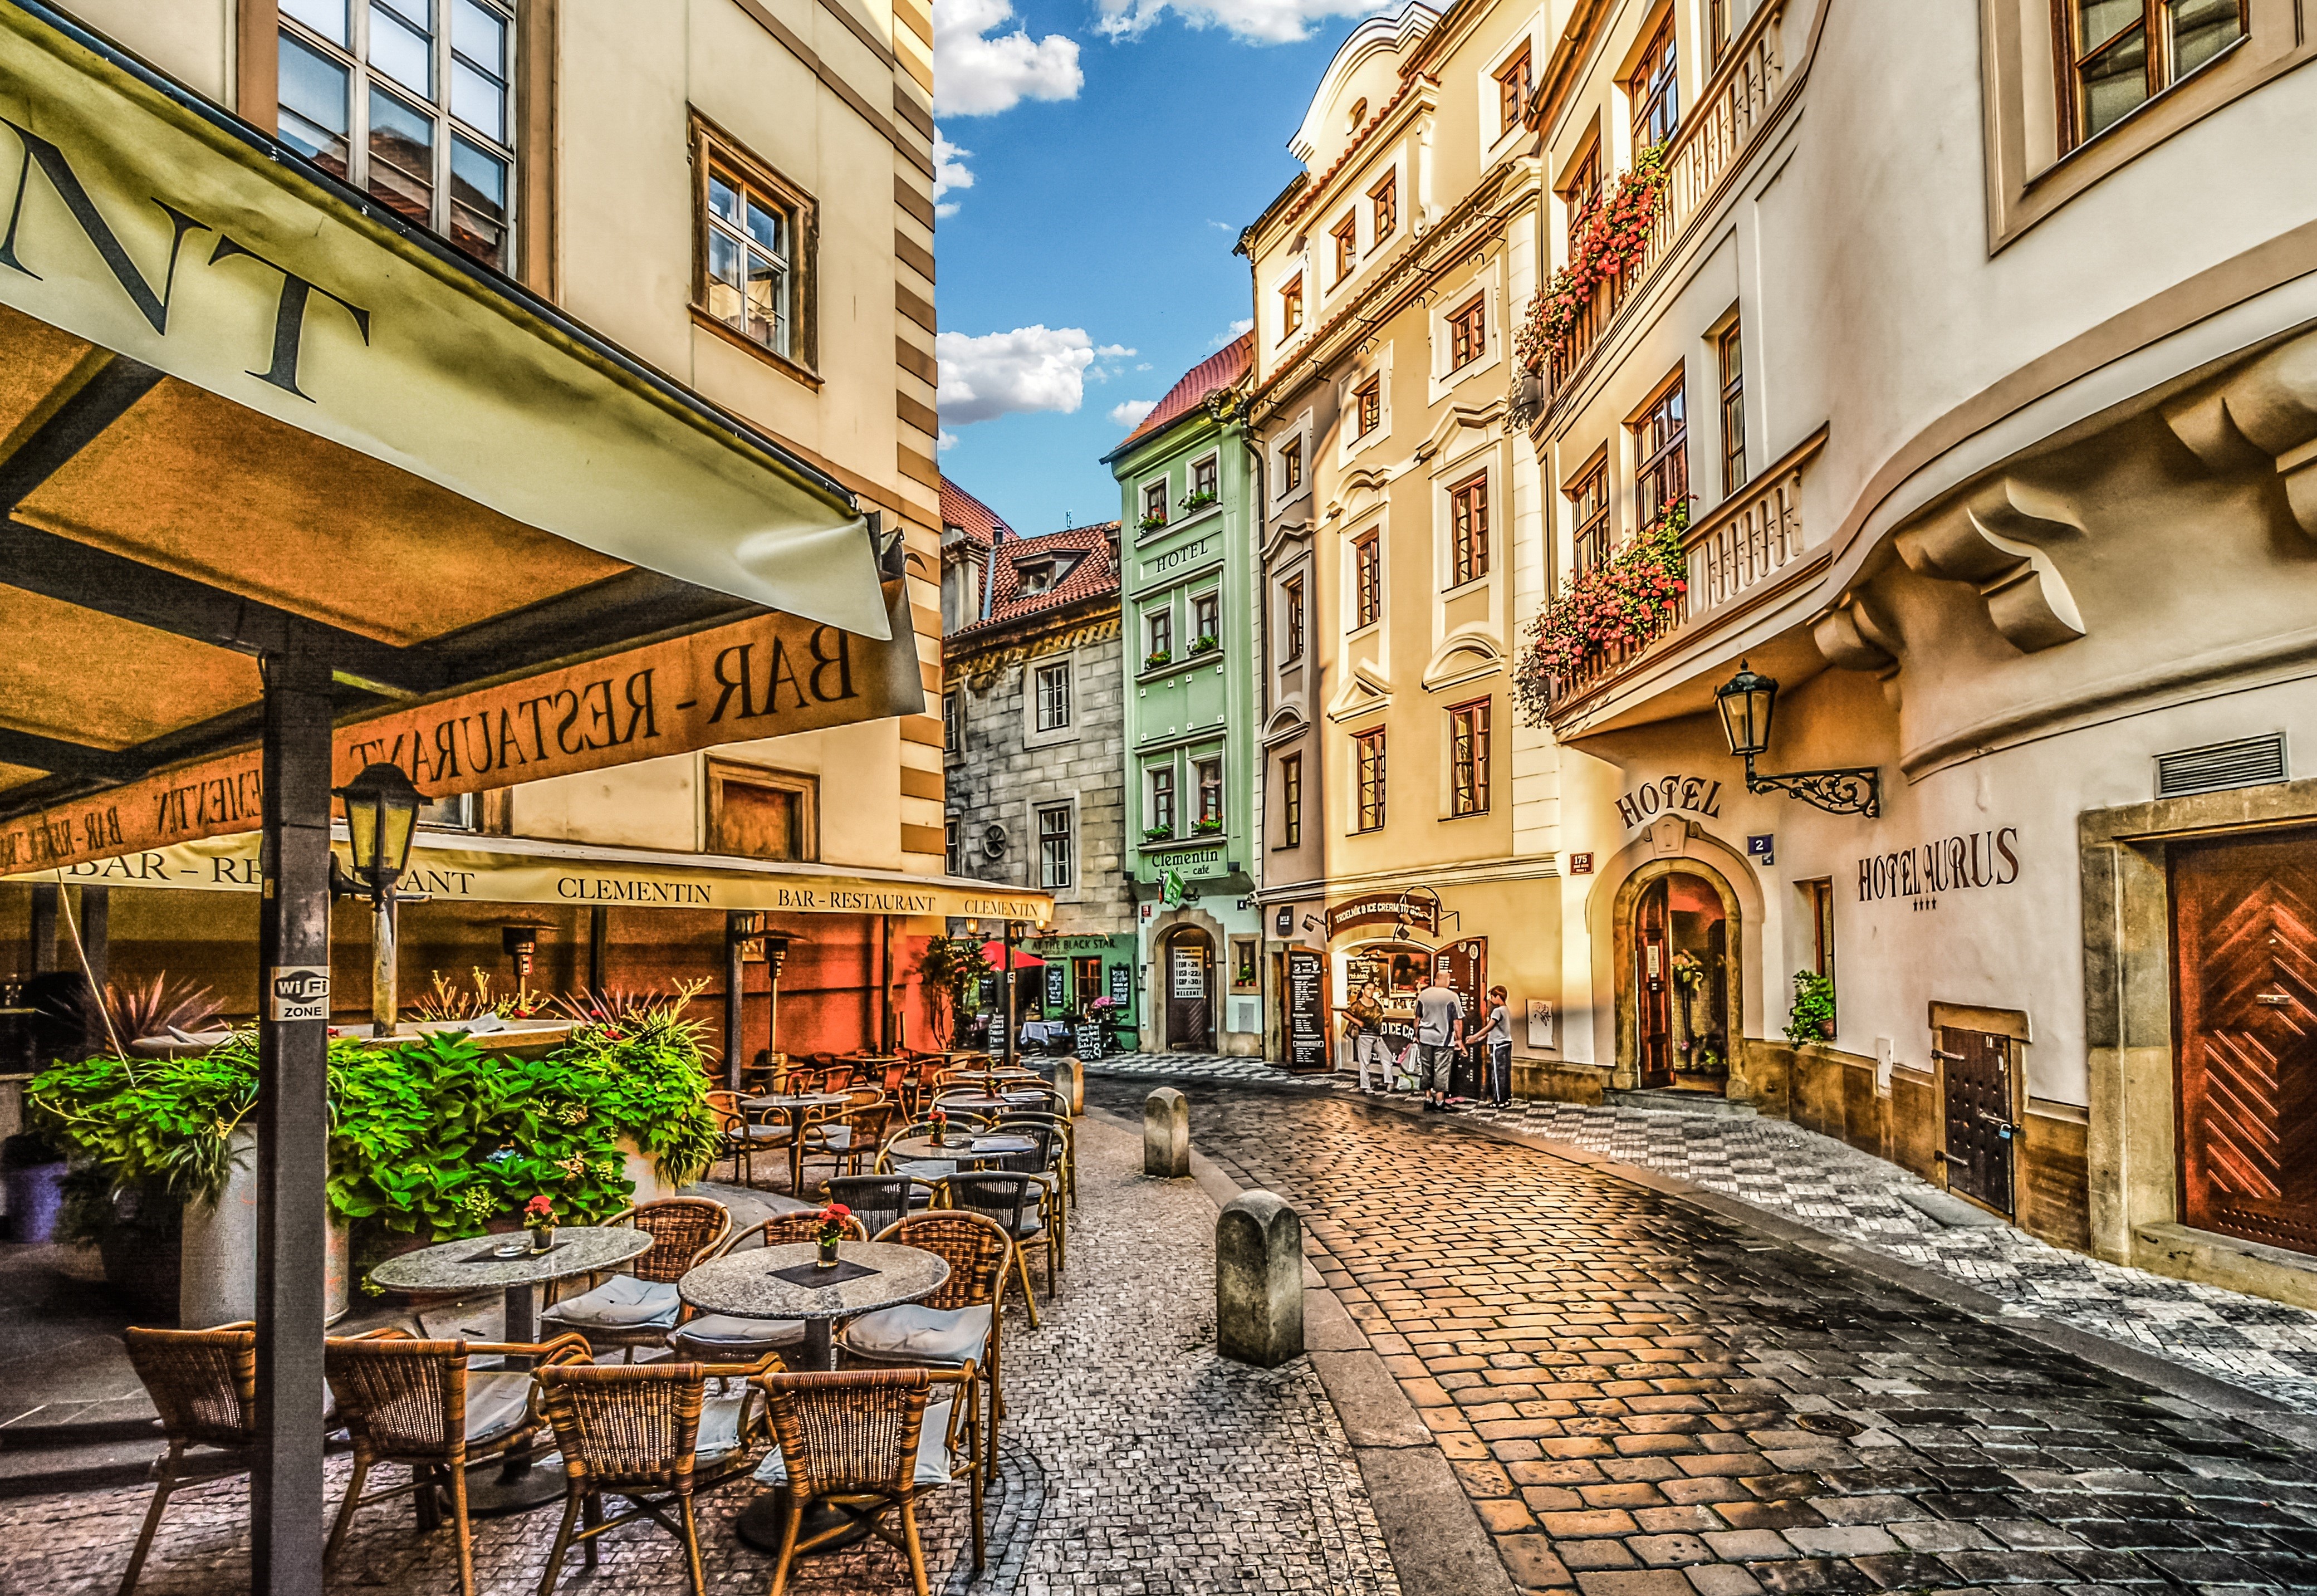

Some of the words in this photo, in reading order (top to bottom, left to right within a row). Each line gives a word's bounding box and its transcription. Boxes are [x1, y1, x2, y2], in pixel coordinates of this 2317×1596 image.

[1157, 540, 1208, 572] HOTEL
[1614, 775, 1722, 829] HOTEL
[1756, 840, 1764, 850] 2
[1152, 849, 1218, 867] Clementin
[1574, 855, 1588, 864] 175
[1193, 865, 1209, 875] café
[1858, 847, 1921, 902] HOTEL
[557, 878, 711, 903] CLEMENTIN
[778, 889, 815, 907] BAR
[830, 892, 935, 911] RESTAURANT
[964, 899, 1038, 917] CLEMENTIN
[1366, 903, 1377, 913] ICE
[1032, 941, 1042, 950] AT
[1044, 940, 1060, 949] THE
[1064, 939, 1090, 949] BLACK
[1094, 938, 1115, 949] STAR
[285, 1007, 322, 1017] ZONE
[1389, 1022, 1402, 1035] ICE
